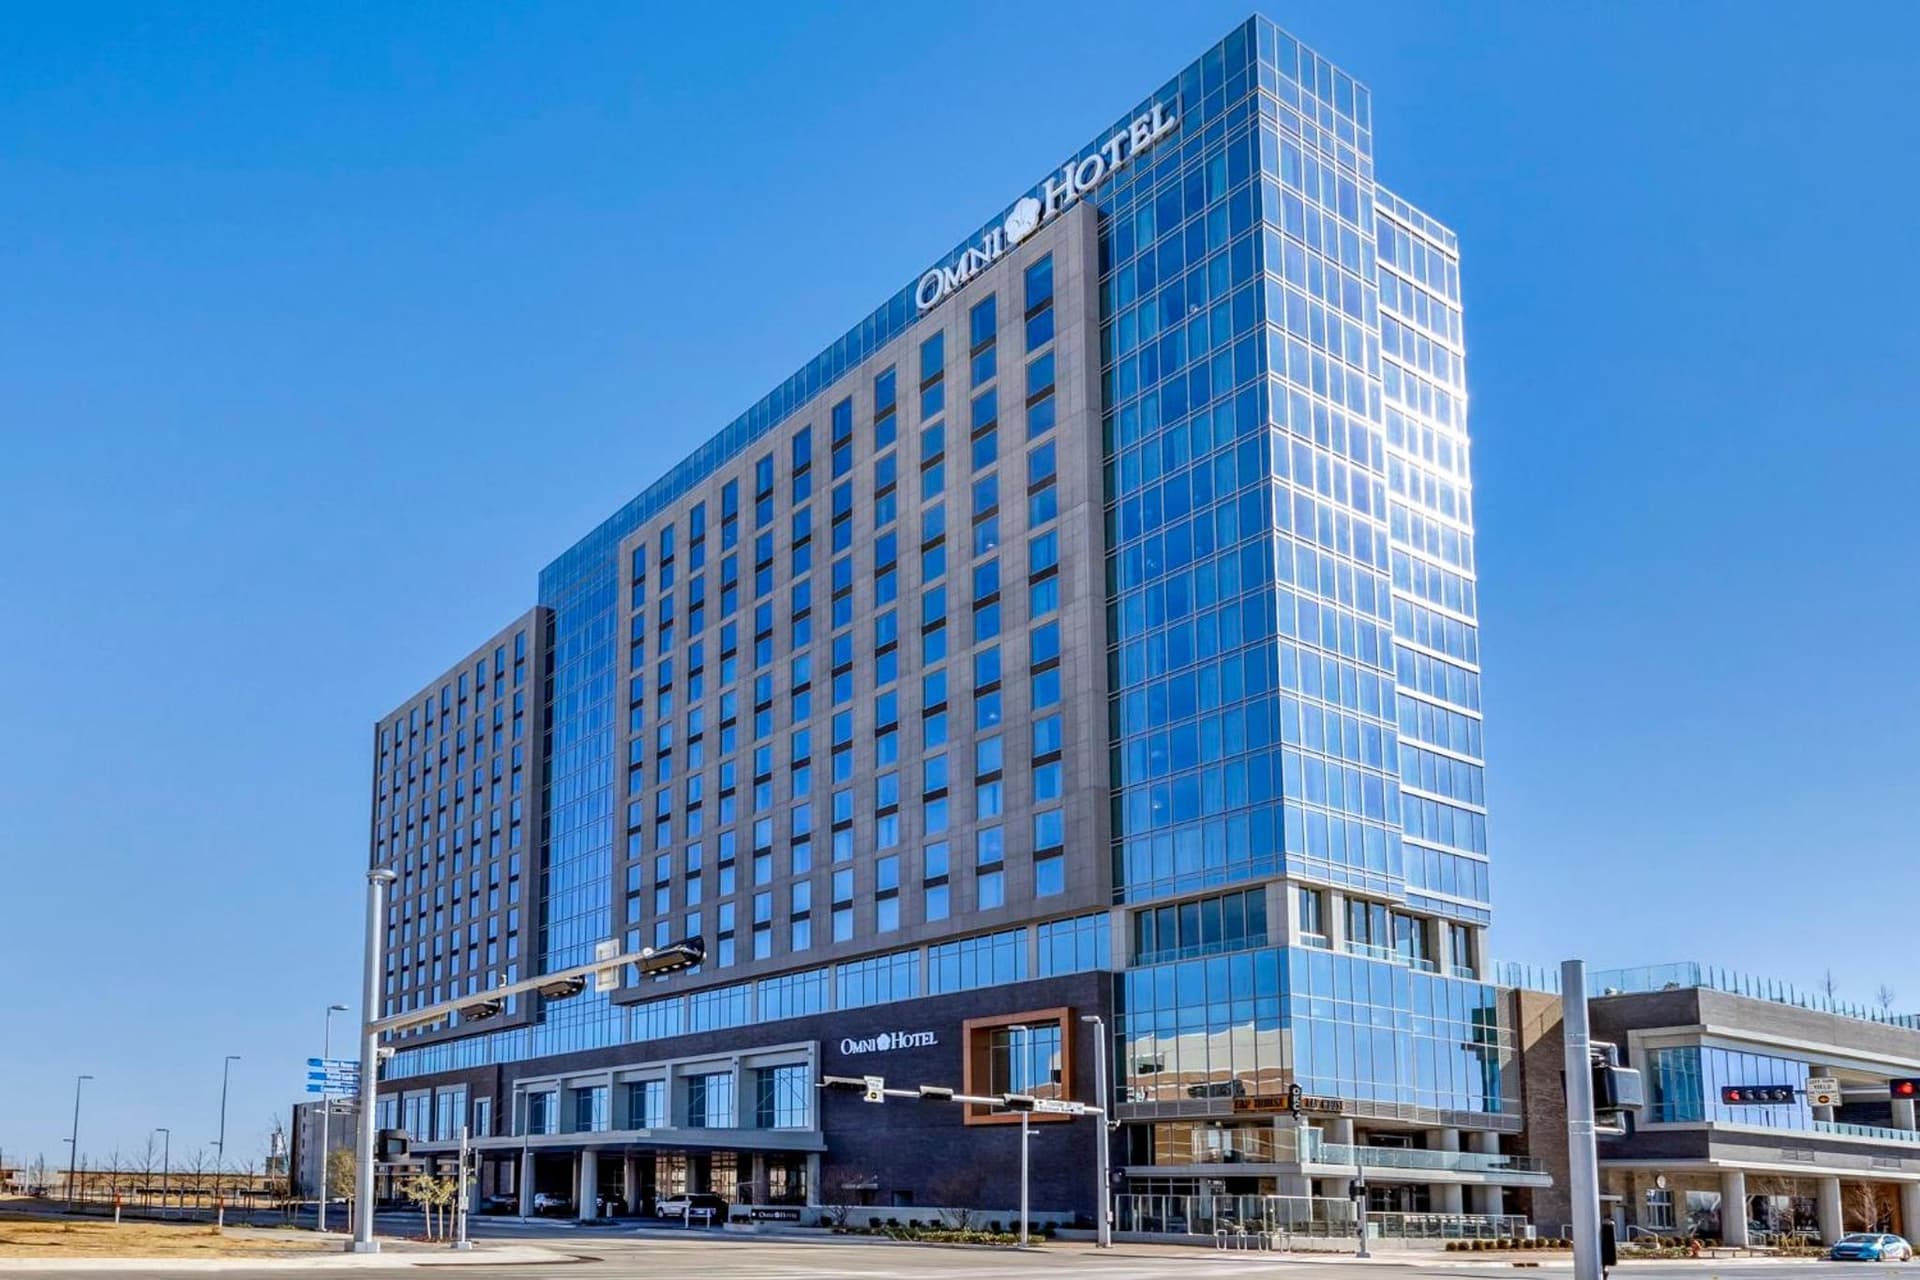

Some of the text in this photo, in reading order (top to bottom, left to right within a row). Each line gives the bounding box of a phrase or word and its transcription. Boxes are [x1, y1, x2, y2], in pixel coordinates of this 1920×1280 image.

[915, 102, 1176, 309] OMNI HOTEL
[841, 1032, 938, 1055] OMNI HOTEL
[1292, 1087, 1301, 1110] OKC
